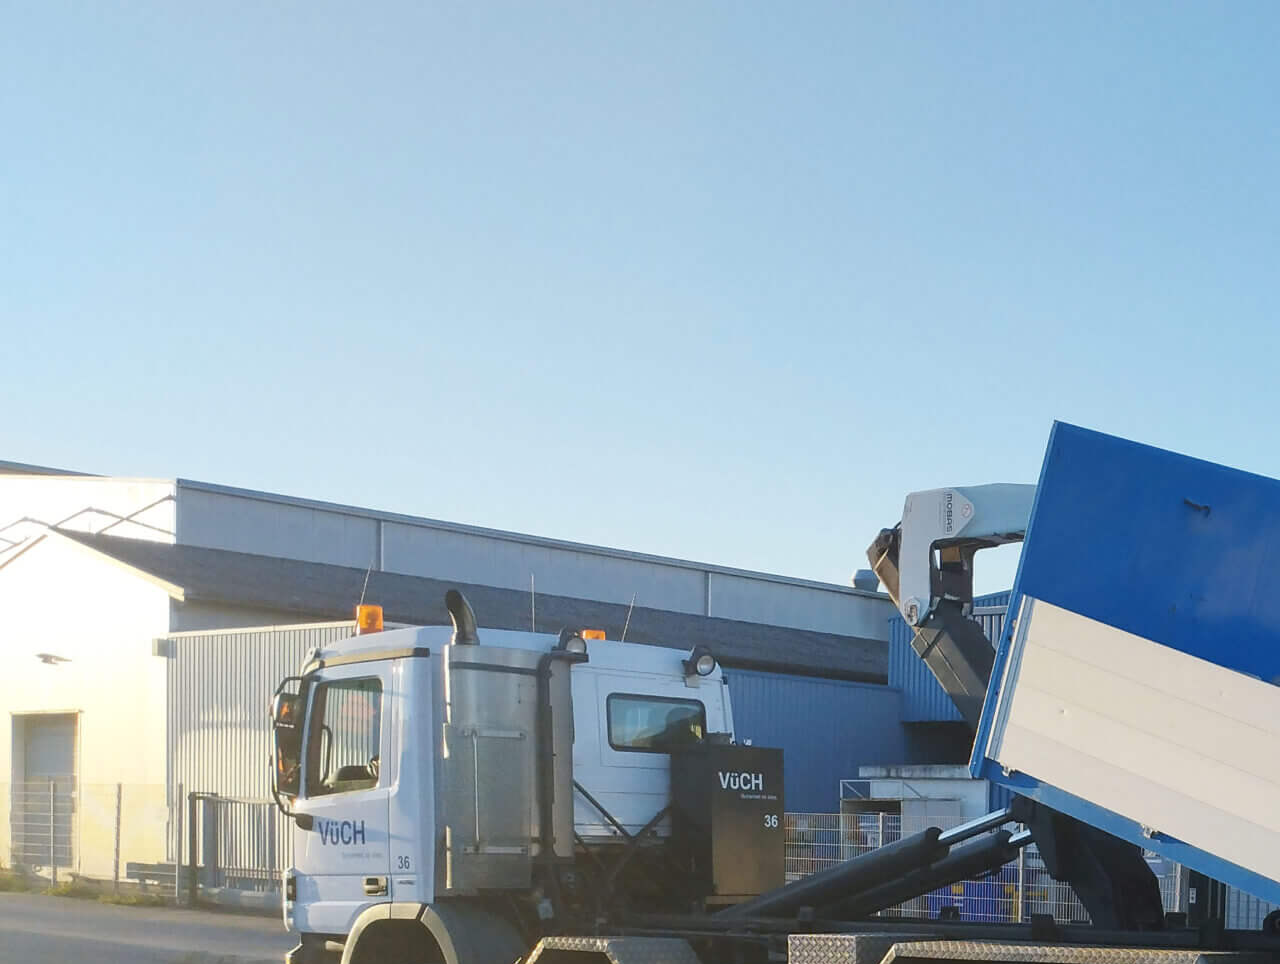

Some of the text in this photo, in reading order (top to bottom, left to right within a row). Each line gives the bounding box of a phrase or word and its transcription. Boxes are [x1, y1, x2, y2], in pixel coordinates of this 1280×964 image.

[718, 771, 763, 791] VüCH
[763, 814, 779, 828] 36
[318, 819, 366, 846] VüCH
[397, 855, 410, 870] 36
